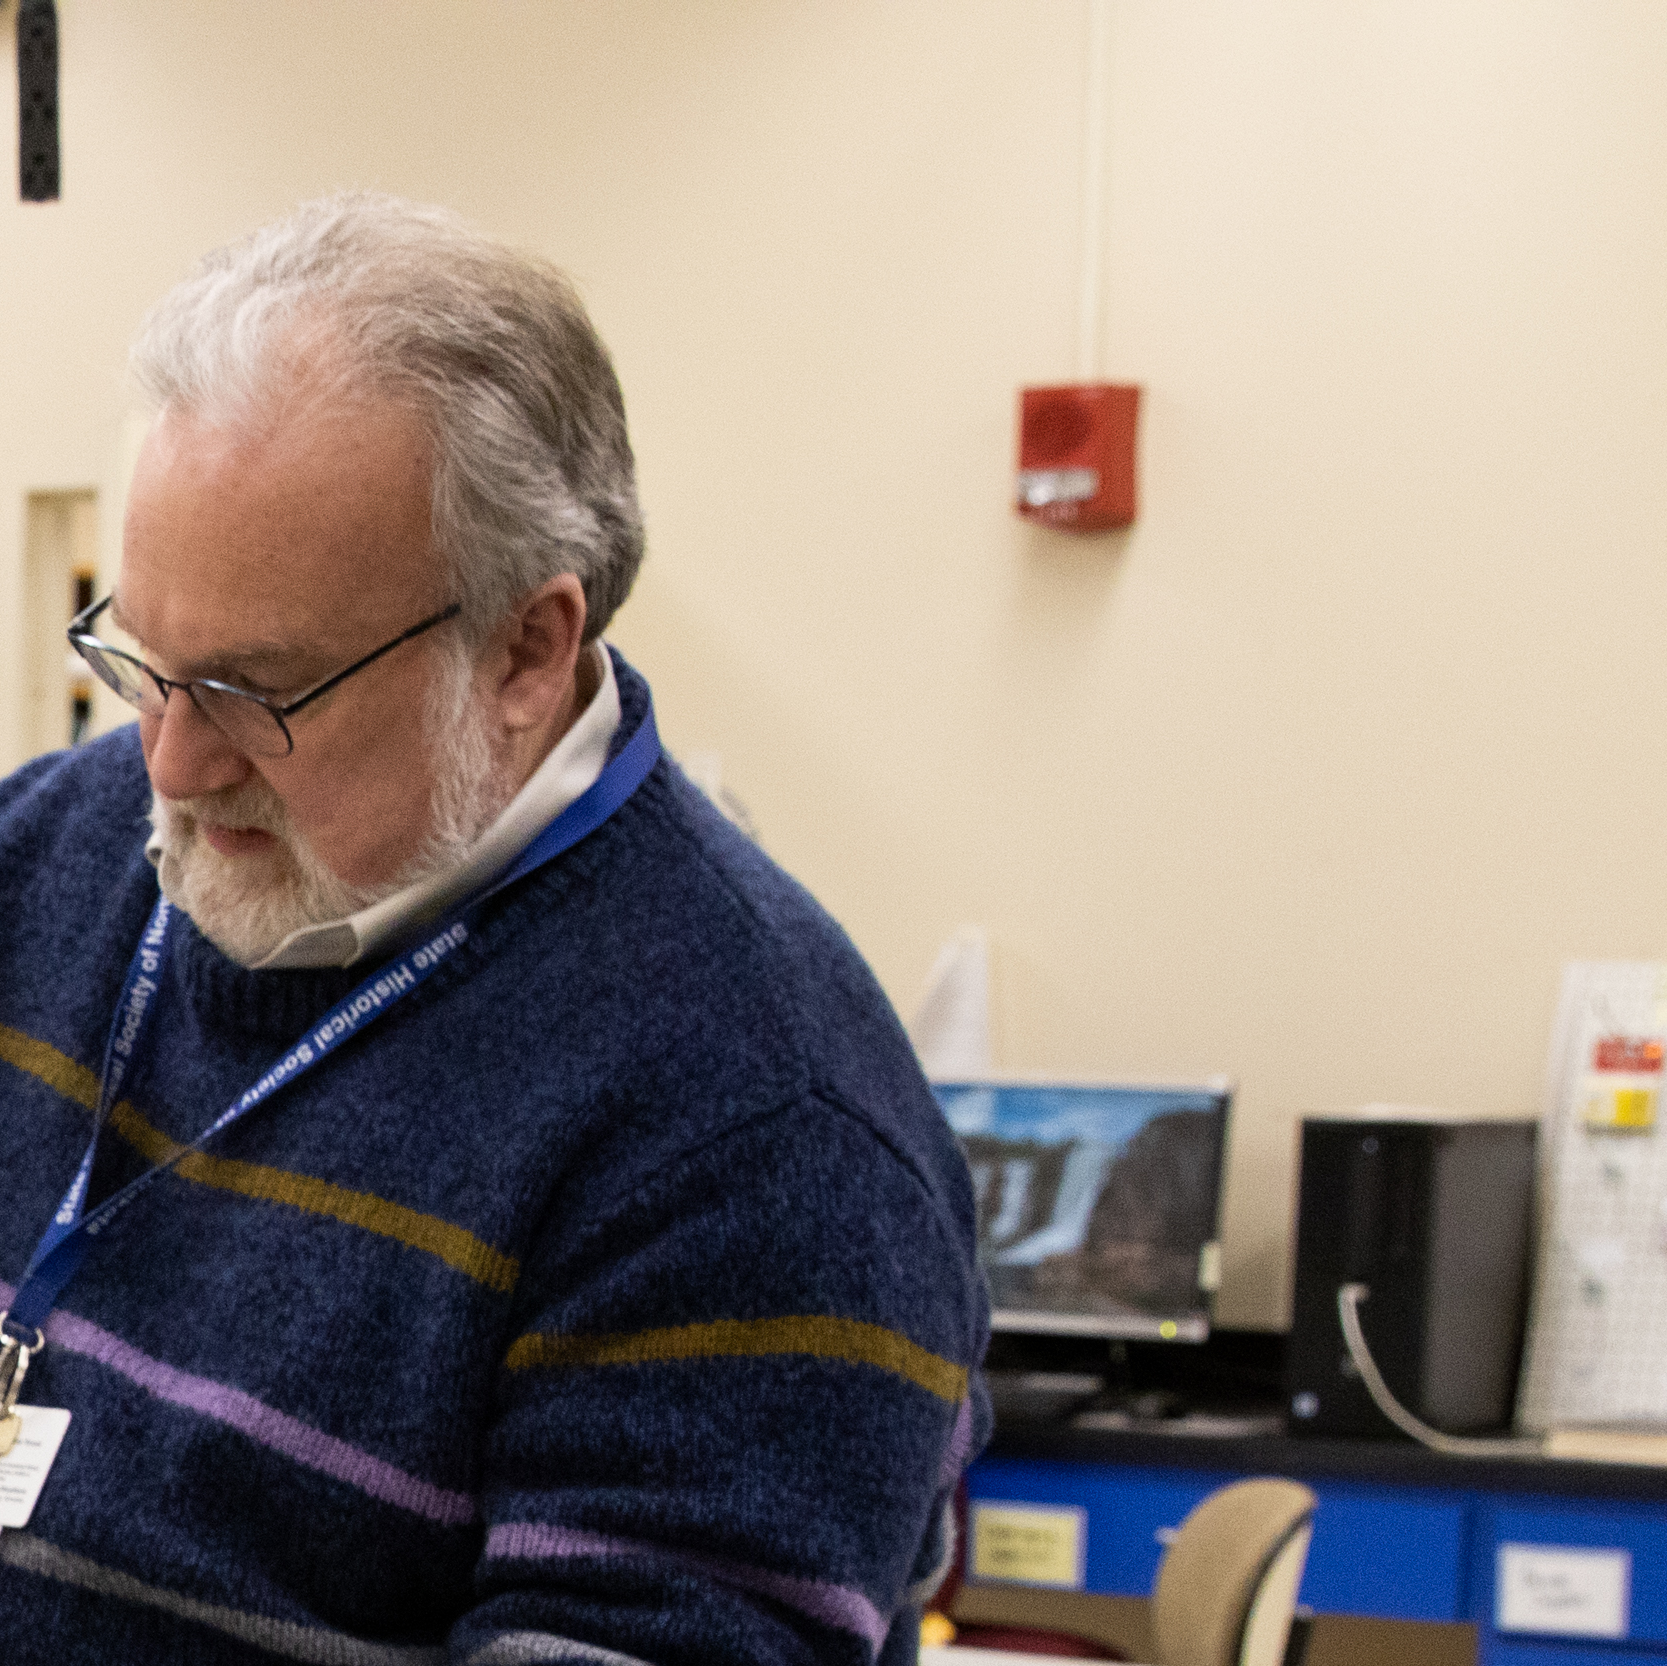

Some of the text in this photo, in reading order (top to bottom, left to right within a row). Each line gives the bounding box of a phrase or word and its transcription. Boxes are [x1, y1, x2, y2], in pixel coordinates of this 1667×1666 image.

[114, 976, 157, 1057] Society
[141, 948, 160, 972] of
[240, 922, 468, 1107] State Historical Society
